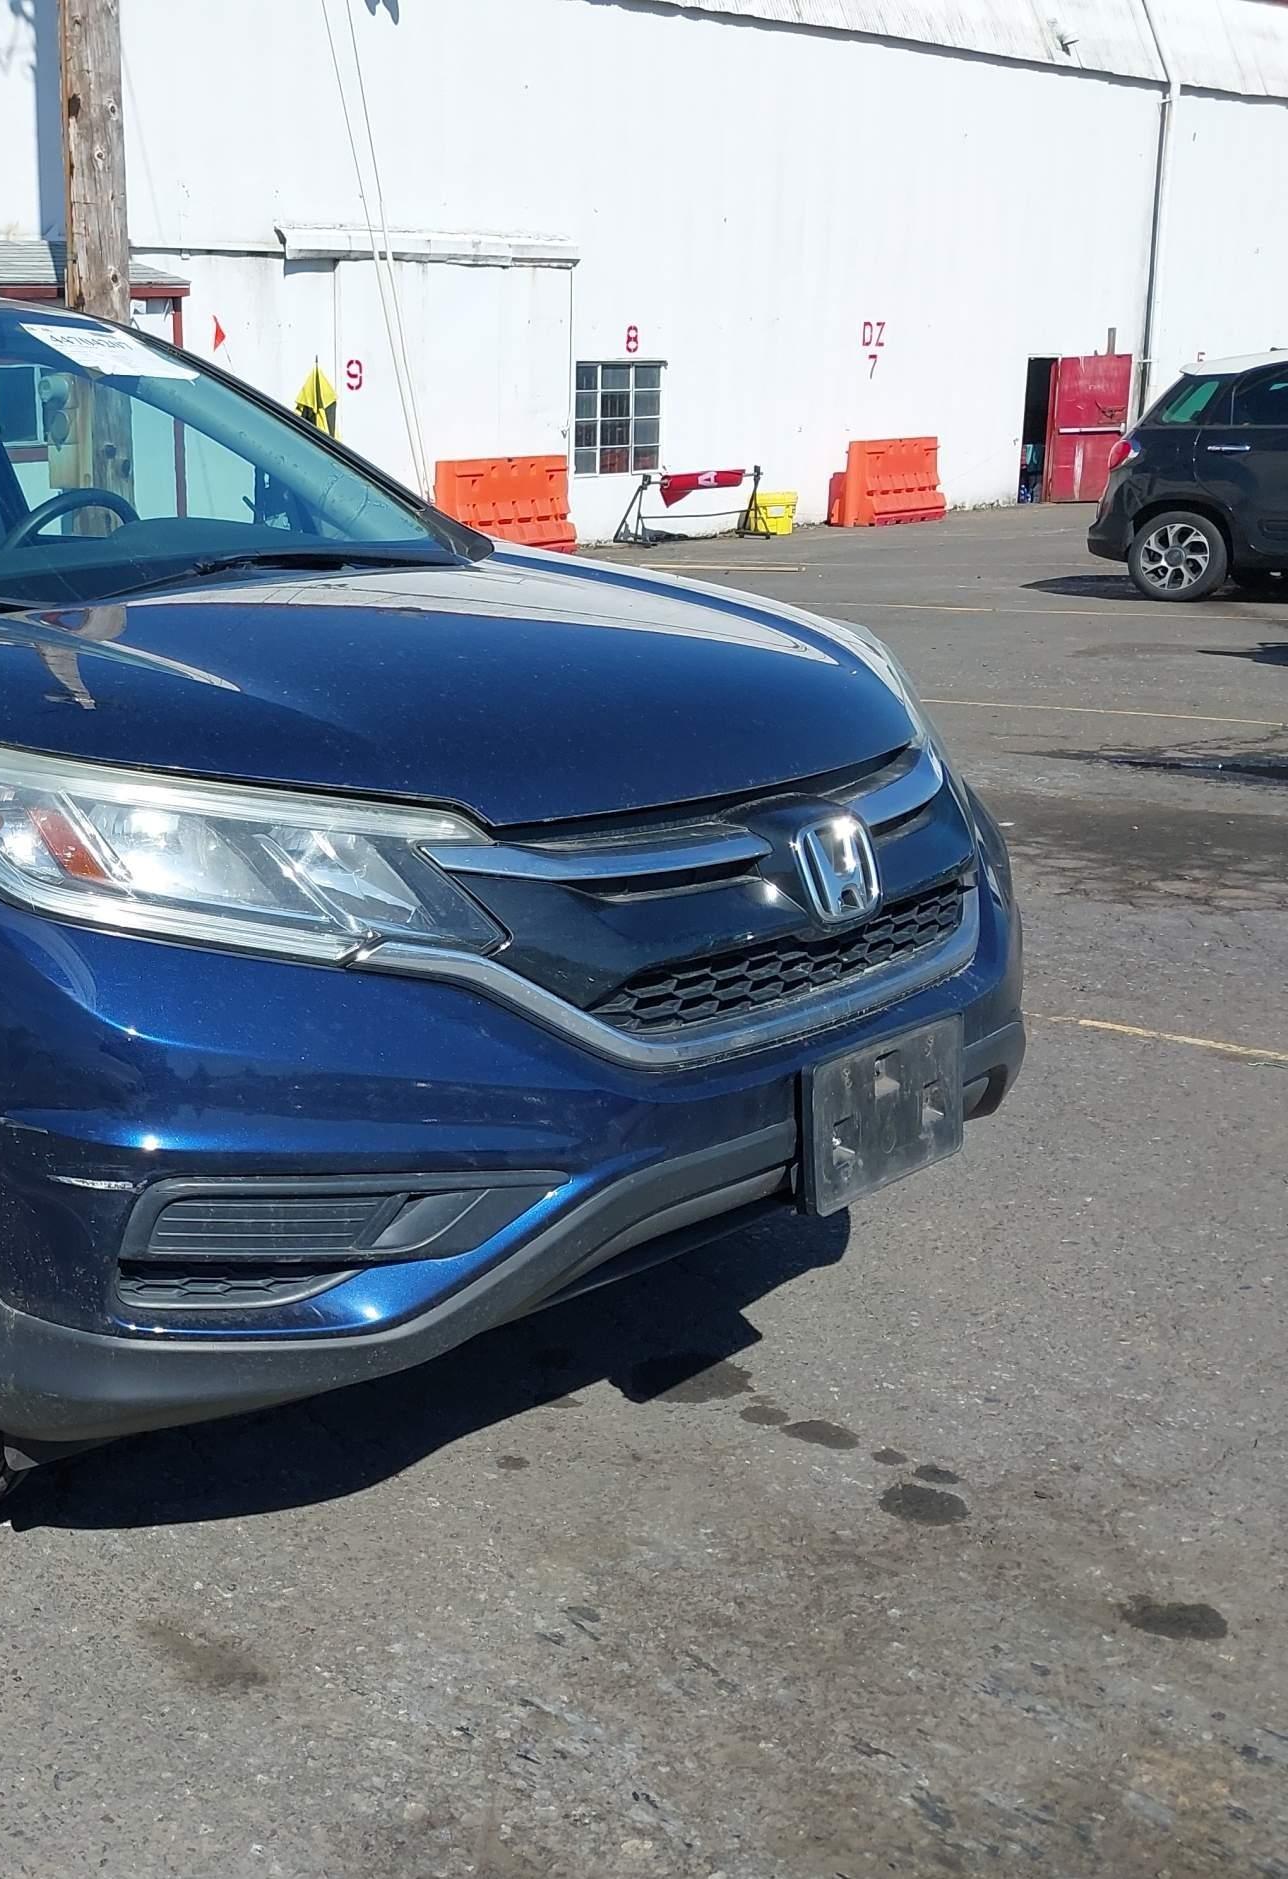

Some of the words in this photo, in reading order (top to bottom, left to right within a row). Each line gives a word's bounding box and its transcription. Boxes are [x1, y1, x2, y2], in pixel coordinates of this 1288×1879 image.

[626, 325, 639, 353] 8
[862, 321, 886, 347] DZ
[346, 359, 363, 391] 9
[868, 354, 878, 380] 7
